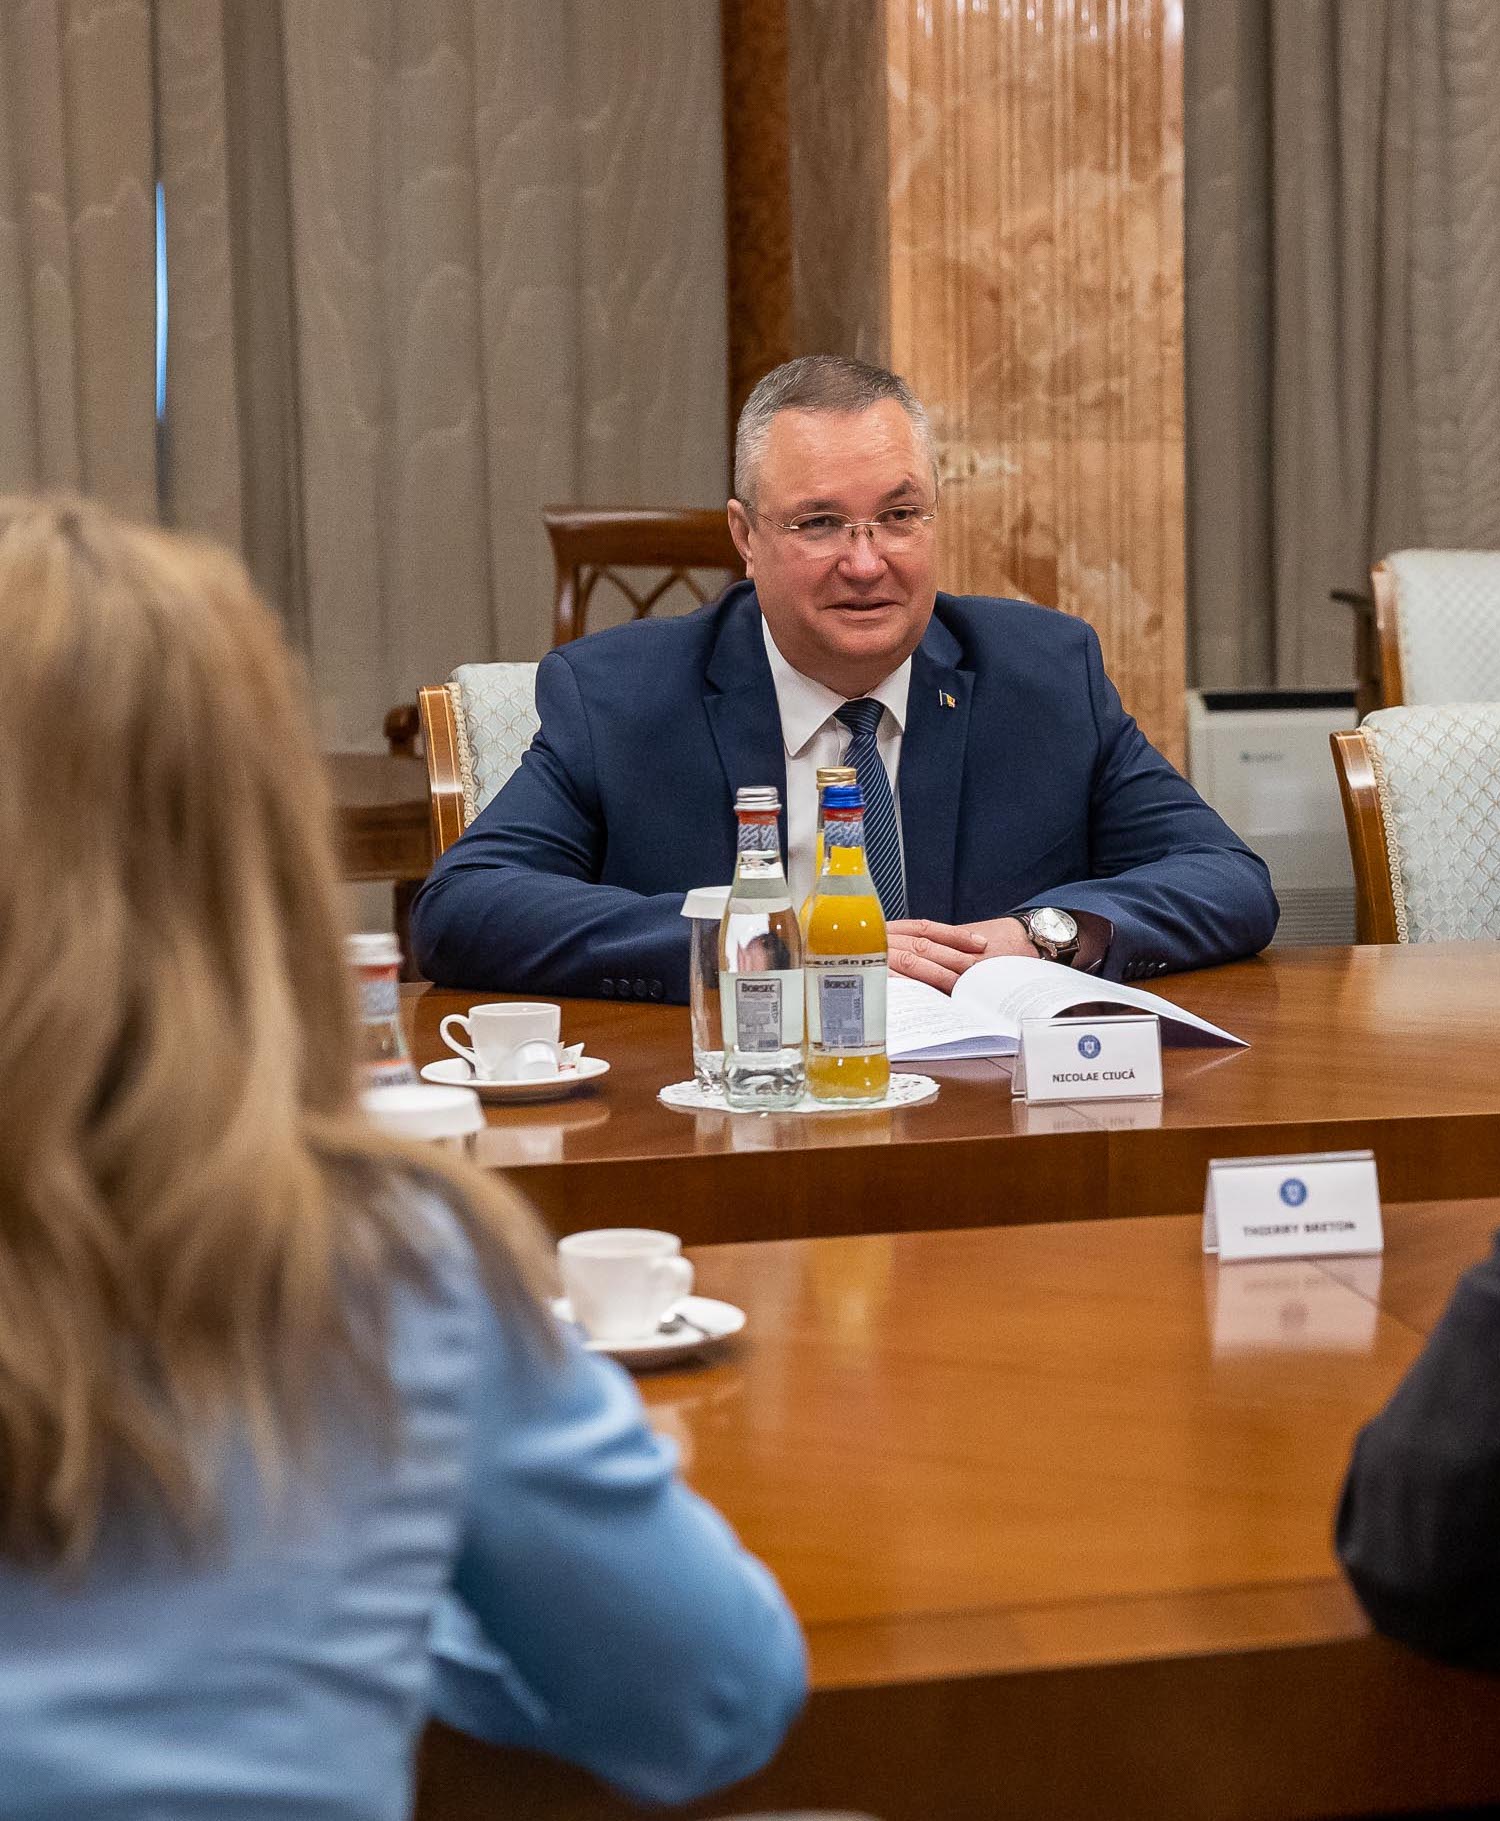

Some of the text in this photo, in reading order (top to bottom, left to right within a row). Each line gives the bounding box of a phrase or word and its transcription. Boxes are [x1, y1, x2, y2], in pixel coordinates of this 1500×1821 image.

[741, 983, 775, 993] BORSEC
[1052, 1068, 1135, 1083] NICOLAE CIUCĂ
